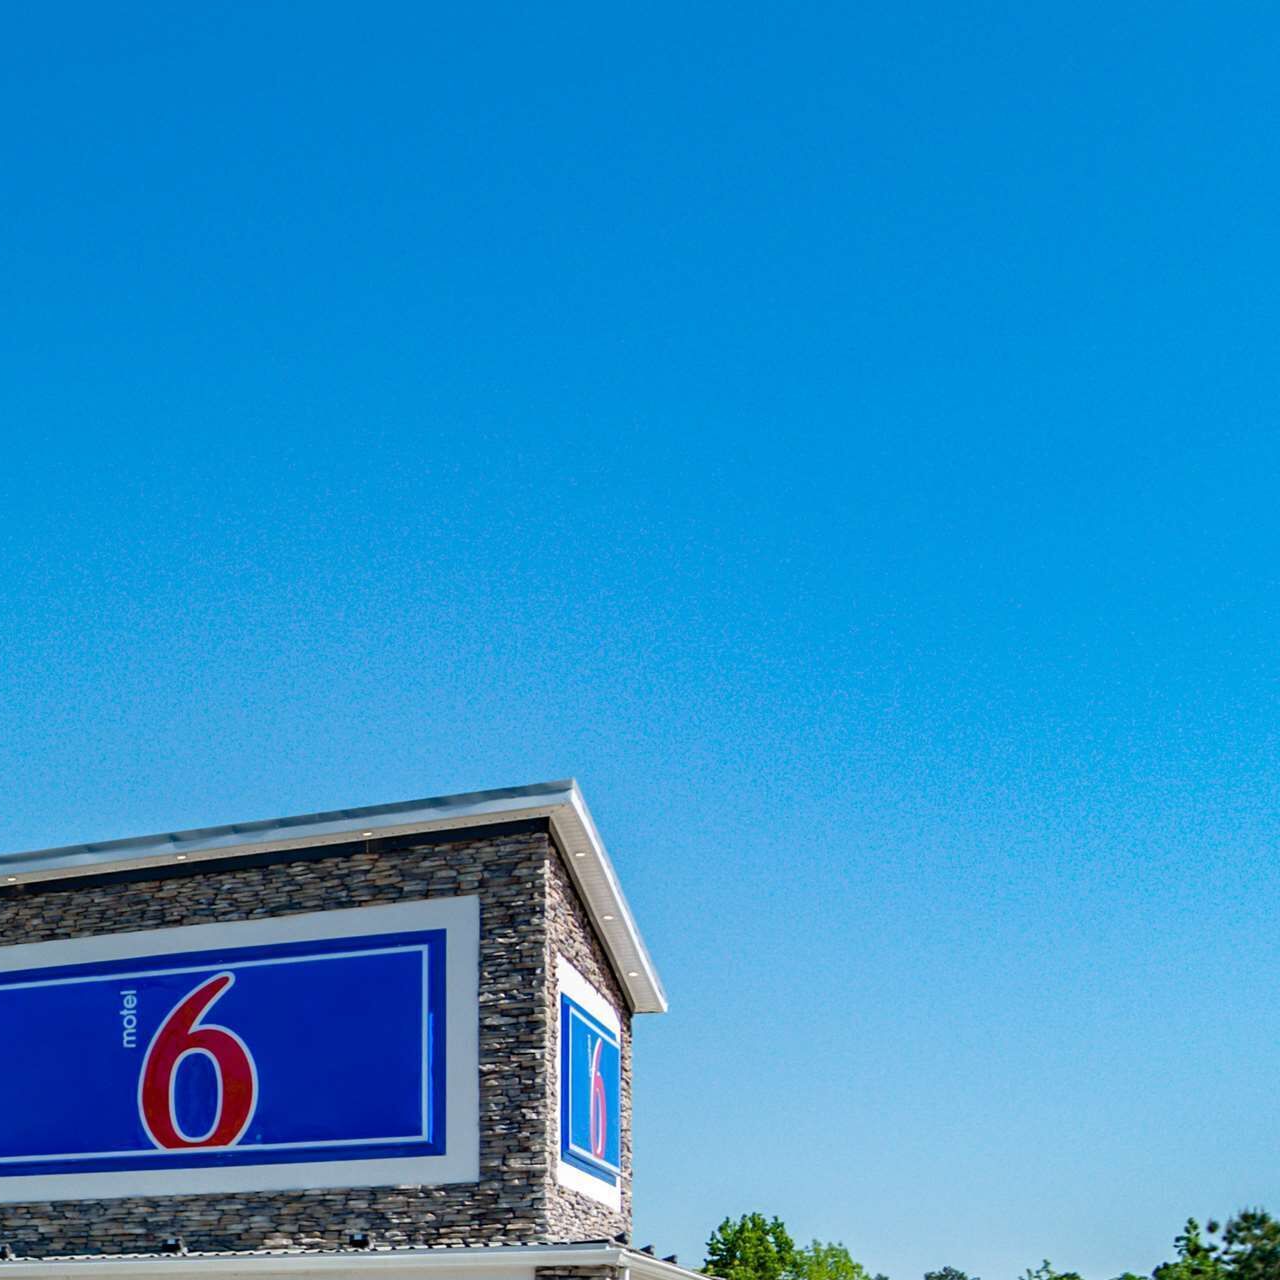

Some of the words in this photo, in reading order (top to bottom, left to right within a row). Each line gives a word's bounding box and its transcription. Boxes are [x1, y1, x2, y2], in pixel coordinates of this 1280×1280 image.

[120, 990, 137, 1048] motel
[137, 971, 259, 1150] 6
[590, 1037, 607, 1160] 6
